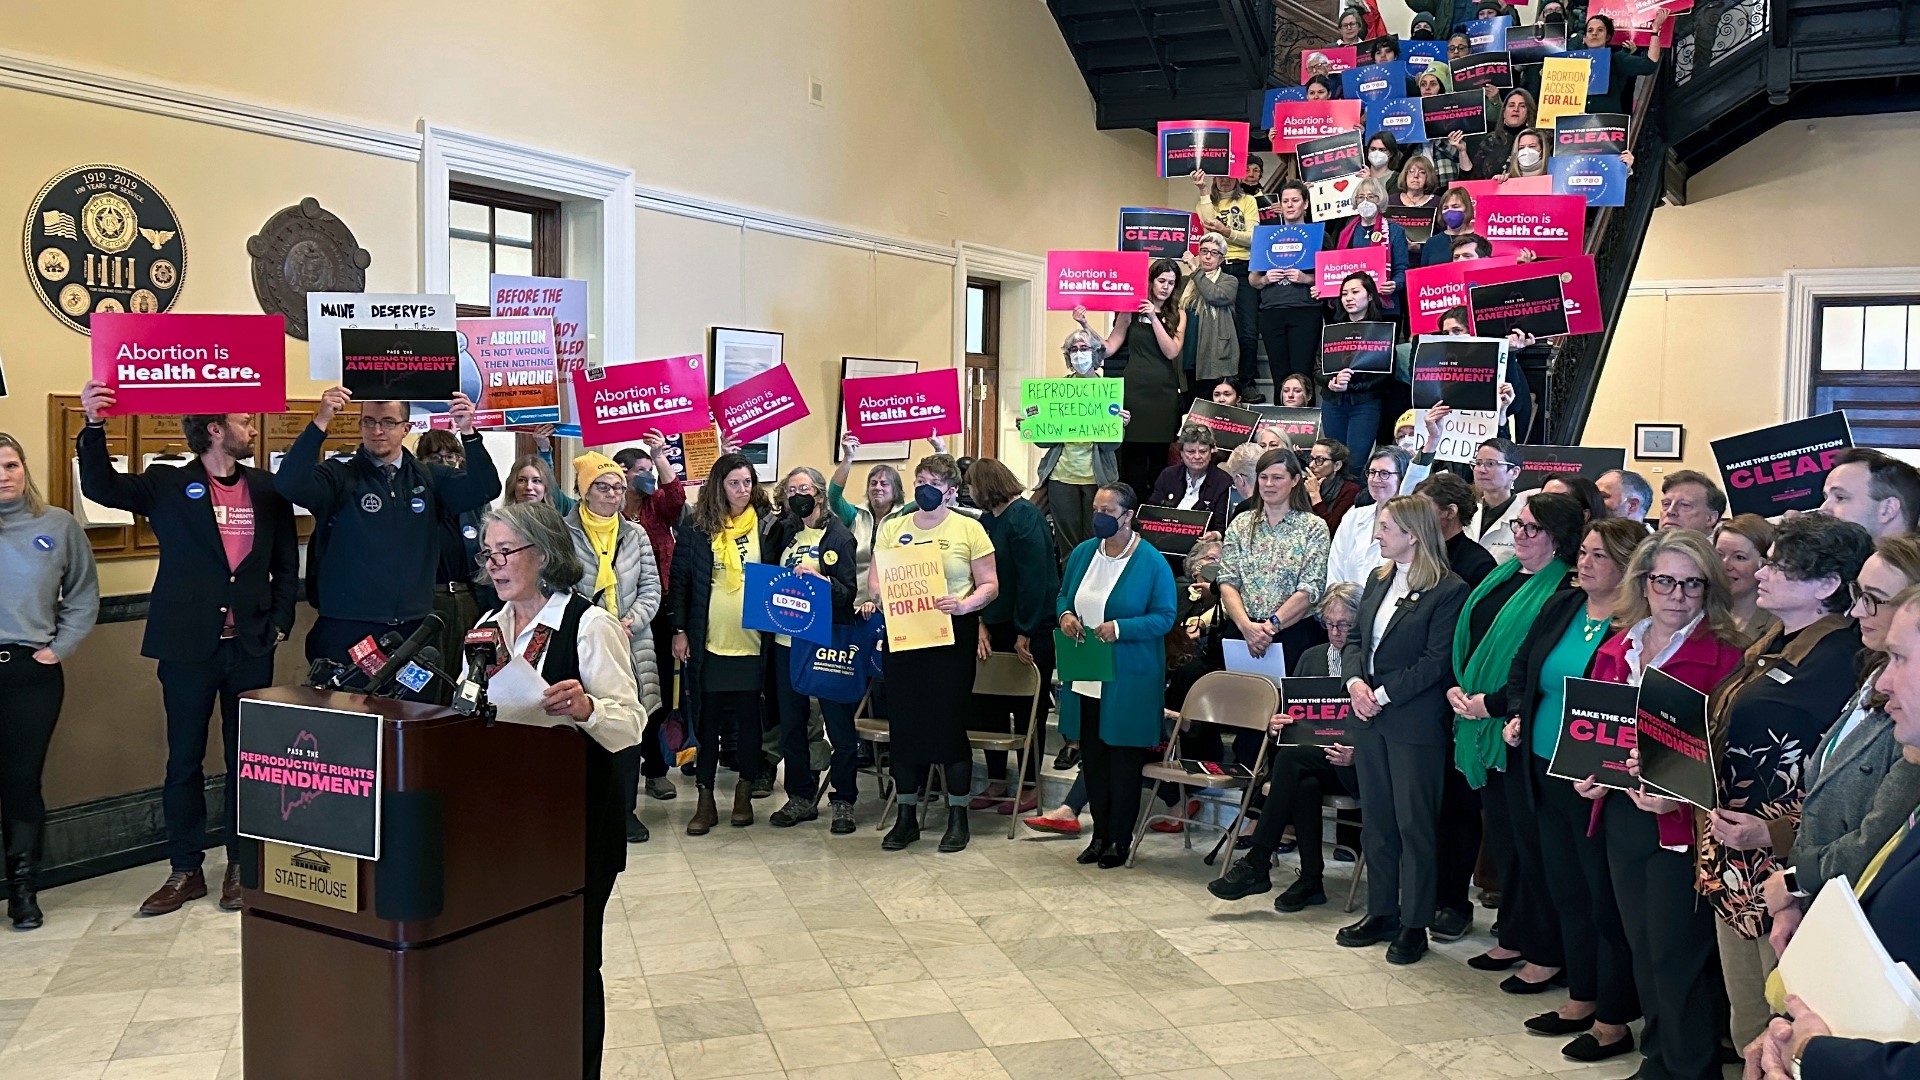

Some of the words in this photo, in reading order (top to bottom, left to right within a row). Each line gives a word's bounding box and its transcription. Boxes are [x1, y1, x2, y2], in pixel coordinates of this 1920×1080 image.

[1454, 65, 1508, 82] CLEAR
[1546, 71, 1586, 82] ABORTION
[1544, 82, 1575, 94] ACCESS
[1543, 95, 1561, 104] FOR
[1284, 115, 1324, 125] Abortion
[1326, 115, 1333, 123] is
[1425, 110, 1482, 122] AMENDMENT
[1283, 126, 1317, 135] Health
[1559, 131, 1625, 144] CLEAR
[1302, 147, 1359, 167] CLEAR
[82, 172, 106, 184] 1919
[114, 174, 138, 190] 2019
[75, 186, 86, 195] 100
[120, 187, 145, 203] SERVICE
[1319, 187, 1324, 195] I
[1316, 203, 1331, 212] LD
[1487, 213, 1539, 224] Abortion
[1542, 213, 1551, 224] is
[1125, 230, 1185, 241] CLEAR
[1487, 225, 1531, 236] Health
[1533, 226, 1568, 236] Care.
[1059, 268, 1106, 279] Abortion
[1109, 269, 1118, 279] is
[1324, 263, 1359, 272] Abortion
[1360, 262, 1366, 270] is
[1059, 280, 1099, 291] Health
[1102, 281, 1134, 291] Care.
[496, 288, 540, 304] BEFORE
[542, 288, 563, 303] THE
[1420, 296, 1461, 310] Health
[321, 303, 354, 319] MAINE
[371, 305, 436, 319] DESERVES
[496, 306, 529, 316] WOMB
[533, 306, 556, 317] YOU
[1475, 302, 1530, 314] REPRODUCTIVE
[1531, 297, 1560, 306] RIGHTS
[1476, 303, 1560, 321] AMENDMENT
[489, 330, 546, 345] ABORTION
[554, 322, 579, 337] ADY
[116, 343, 208, 360] Abortion
[214, 344, 229, 359] is
[481, 349, 491, 357] IS
[494, 348, 512, 356] NOT
[515, 347, 550, 356] WRONG
[556, 340, 585, 355] LLED
[1324, 344, 1390, 353] AMENDMENT
[345, 362, 455, 370] AMENDMENT
[484, 360, 509, 368] THEN
[512, 359, 553, 367] NOTHING
[557, 357, 585, 372] NTED
[118, 364, 196, 380] Health
[202, 365, 260, 380] Care.
[489, 372, 503, 387] IS
[506, 370, 553, 386] WRONG
[1415, 373, 1493, 382] AMENDMENT
[594, 386, 657, 404] Abortion
[660, 382, 671, 394] is
[1028, 383, 1119, 399] REPRODUCTIVE
[596, 400, 651, 418] Health
[653, 396, 692, 410] Care.
[724, 395, 764, 418] Abortion
[764, 390, 773, 401] is
[859, 394, 913, 408] Abortion
[916, 393, 926, 403] is
[728, 405, 762, 427] Health
[763, 395, 792, 411] Care.
[860, 409, 907, 421] Health
[910, 405, 945, 417] Care.
[1050, 402, 1104, 419] FREEDOM
[1036, 422, 1063, 437] NOW
[1080, 422, 1119, 438] ALWAYS
[1189, 417, 1251, 435] AMENDMENT
[1445, 419, 1487, 436] OULD
[1416, 433, 1482, 459] DCIDE
[1726, 460, 1752, 470] MAKE
[1753, 456, 1770, 465] THE
[1770, 439, 1843, 460] CONSTITUTION
[1143, 524, 1202, 535] MENDMENT
[884, 561, 939, 583] ABORTION
[888, 580, 928, 600] ACCESS
[790, 600, 807, 610] 780
[889, 600, 914, 616] FOR
[816, 647, 856, 664] GRR!
[1287, 705, 1350, 720] CLEA
[1572, 709, 1599, 718] MAKE
[1601, 713, 1619, 722] THE
[1569, 719, 1637, 748] CLE
[1638, 708, 1680, 737] REPRODUCTIVE
[1681, 731, 1707, 749] RIGHTS
[1638, 719, 1707, 763] AMENDMENT
[287, 747, 303, 756] PASS
[306, 750, 319, 758] THE
[241, 751, 328, 773] REPRODUCTIVE
[329, 764, 374, 779] RIGHTS
[240, 763, 373, 797] AMENDMENT
[275, 868, 306, 890] STATE
[310, 875, 347, 899] HOUSE
